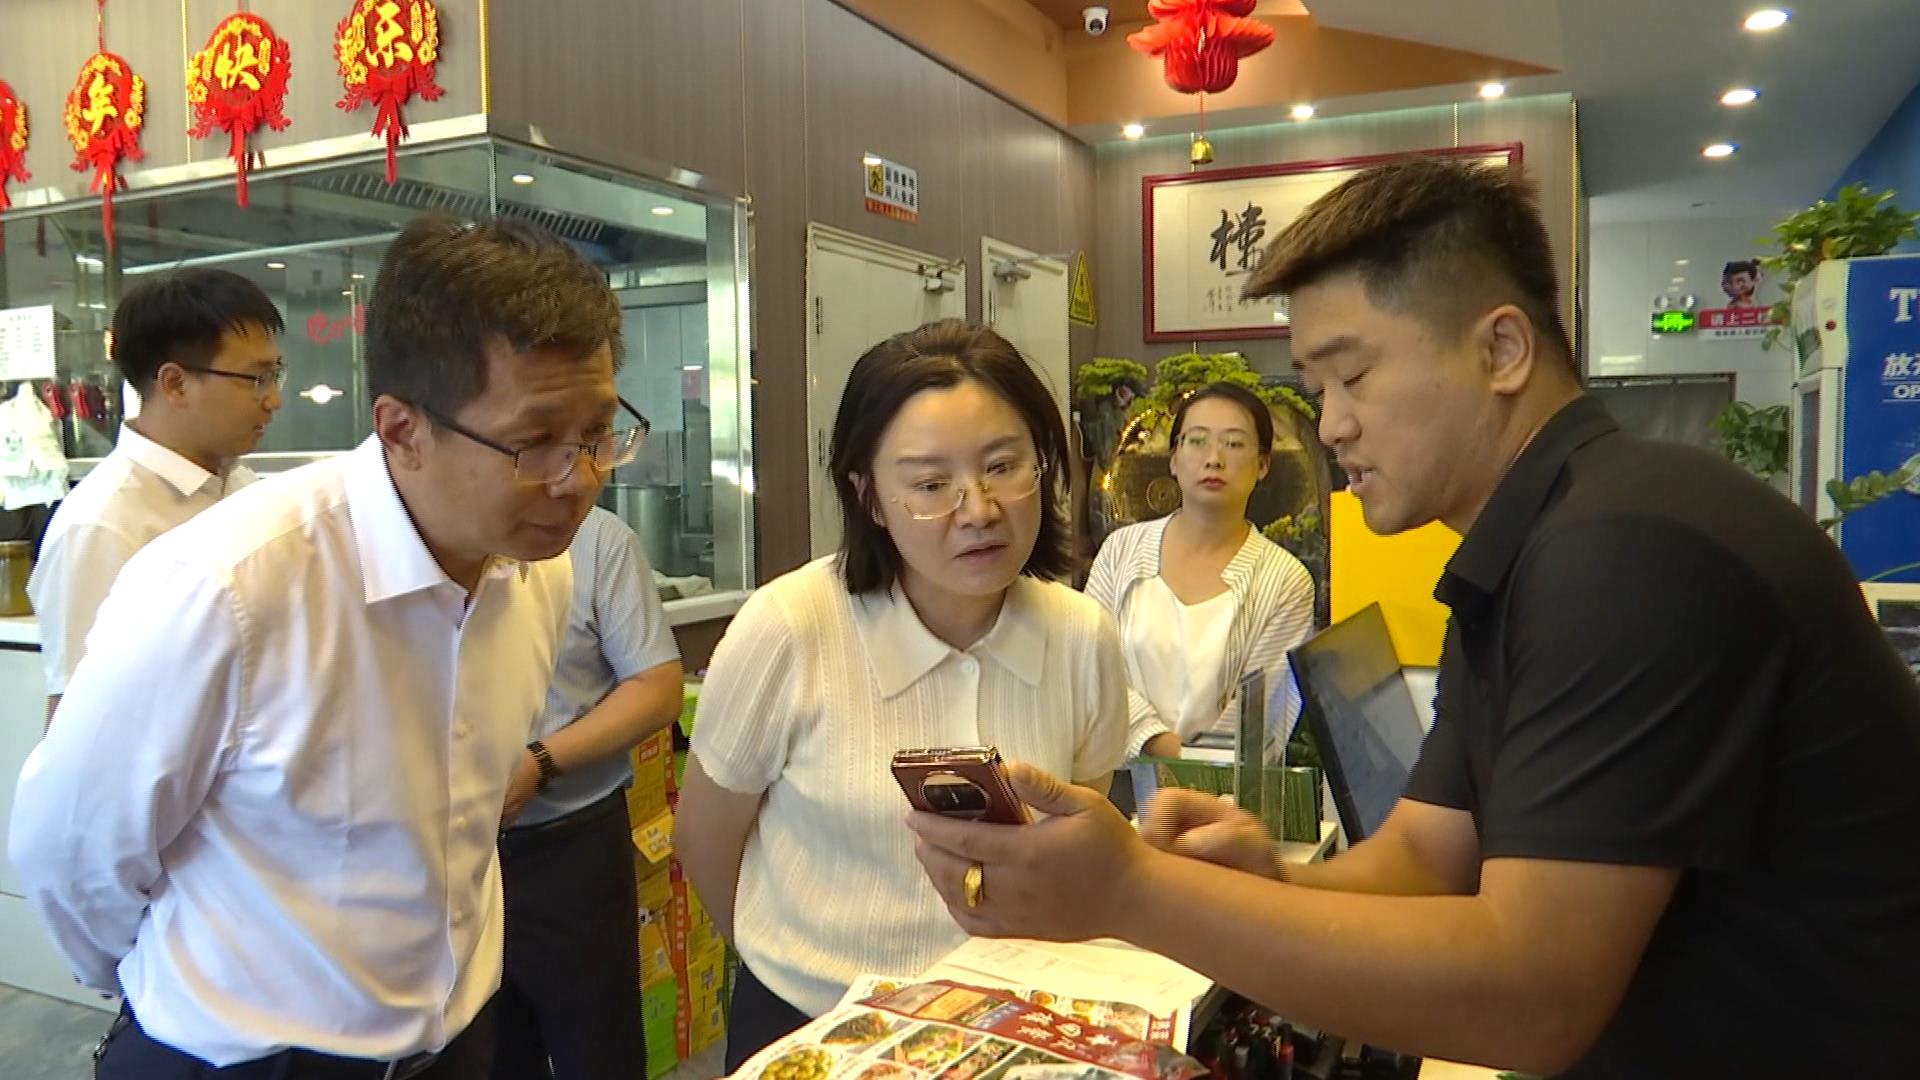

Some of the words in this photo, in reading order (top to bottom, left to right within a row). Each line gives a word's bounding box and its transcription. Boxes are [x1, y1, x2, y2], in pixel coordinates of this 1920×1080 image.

[214, 36, 260, 91] 快
[365, 2, 413, 69] 乐
[82, 72, 119, 135] 年
[1889, 287, 1920, 323] T
